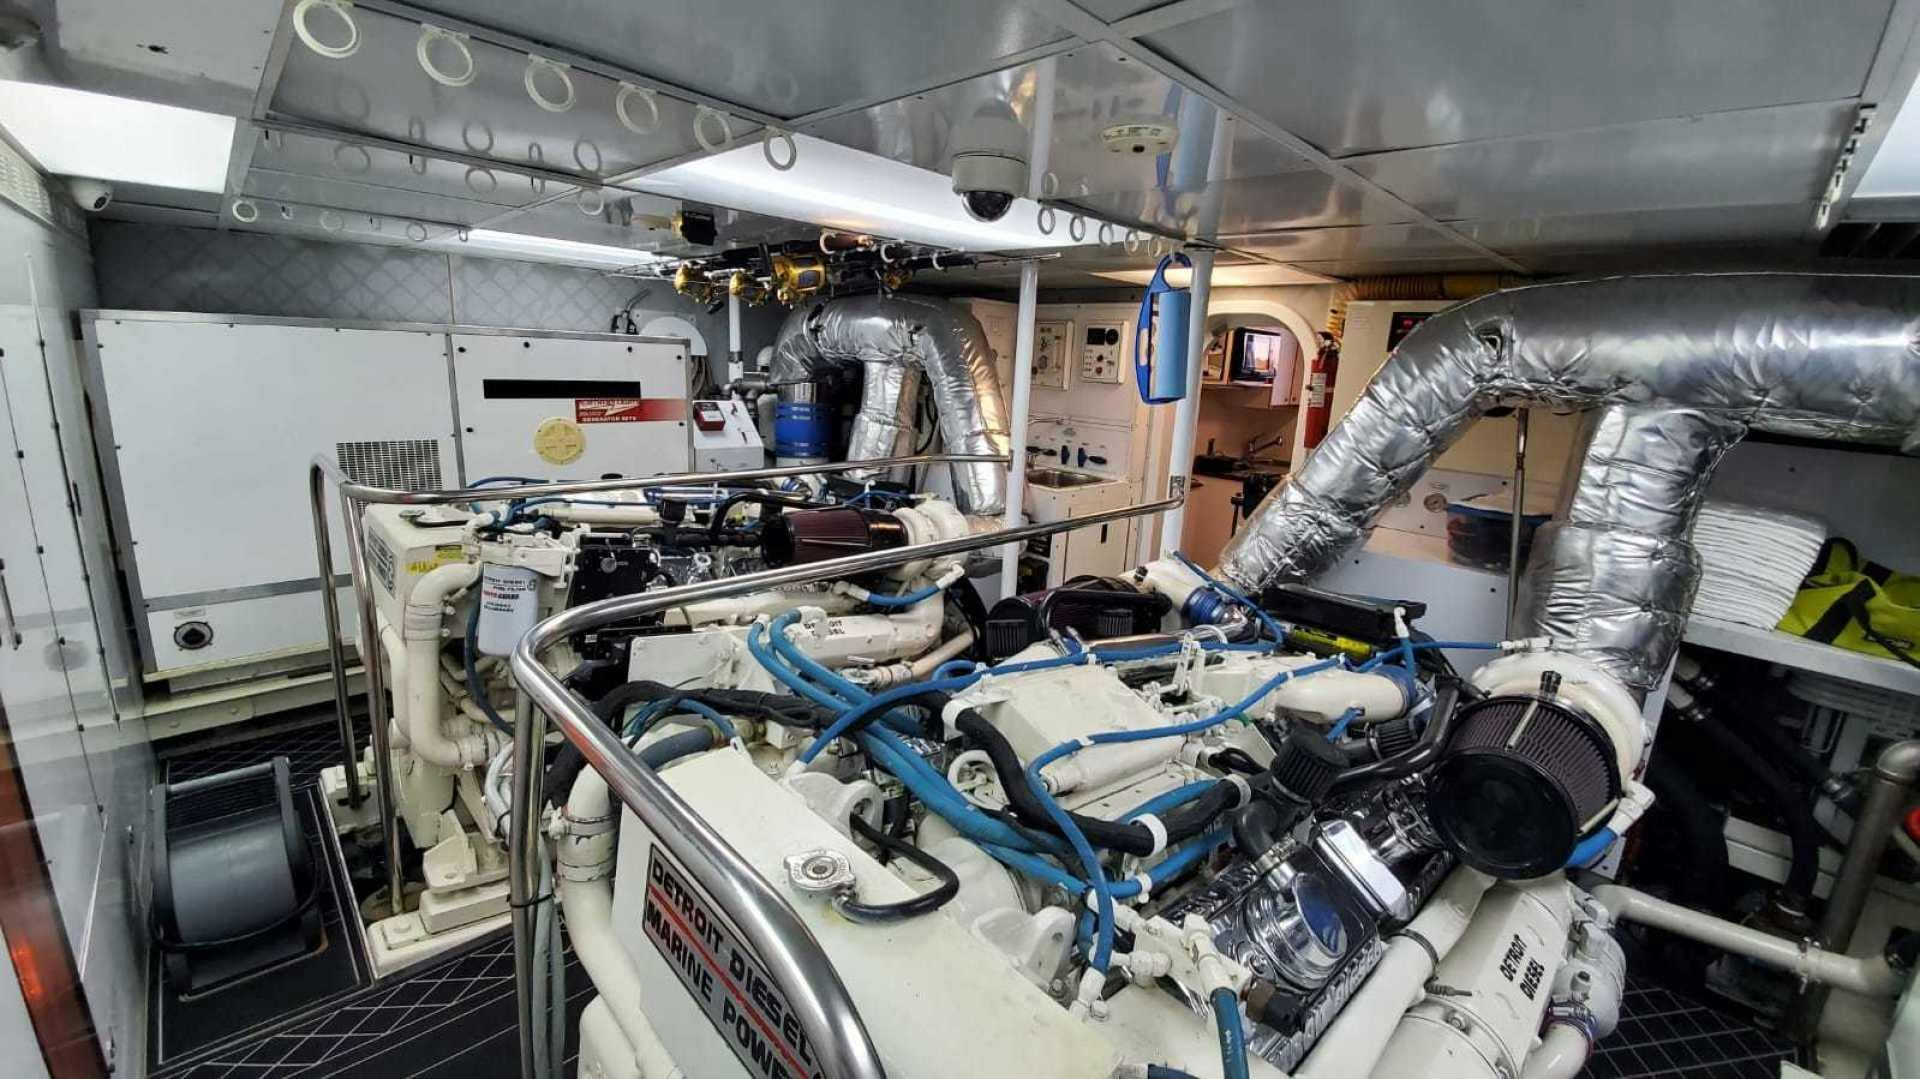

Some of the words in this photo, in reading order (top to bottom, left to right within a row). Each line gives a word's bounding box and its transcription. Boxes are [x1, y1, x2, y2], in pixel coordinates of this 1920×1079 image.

[646, 899, 715, 1003] MARINE
[652, 857, 724, 954] DETROIT
[729, 948, 813, 1065] DIESEL
[1499, 933, 1527, 981] DETROIT
[1519, 957, 1545, 1000] DIESEL
